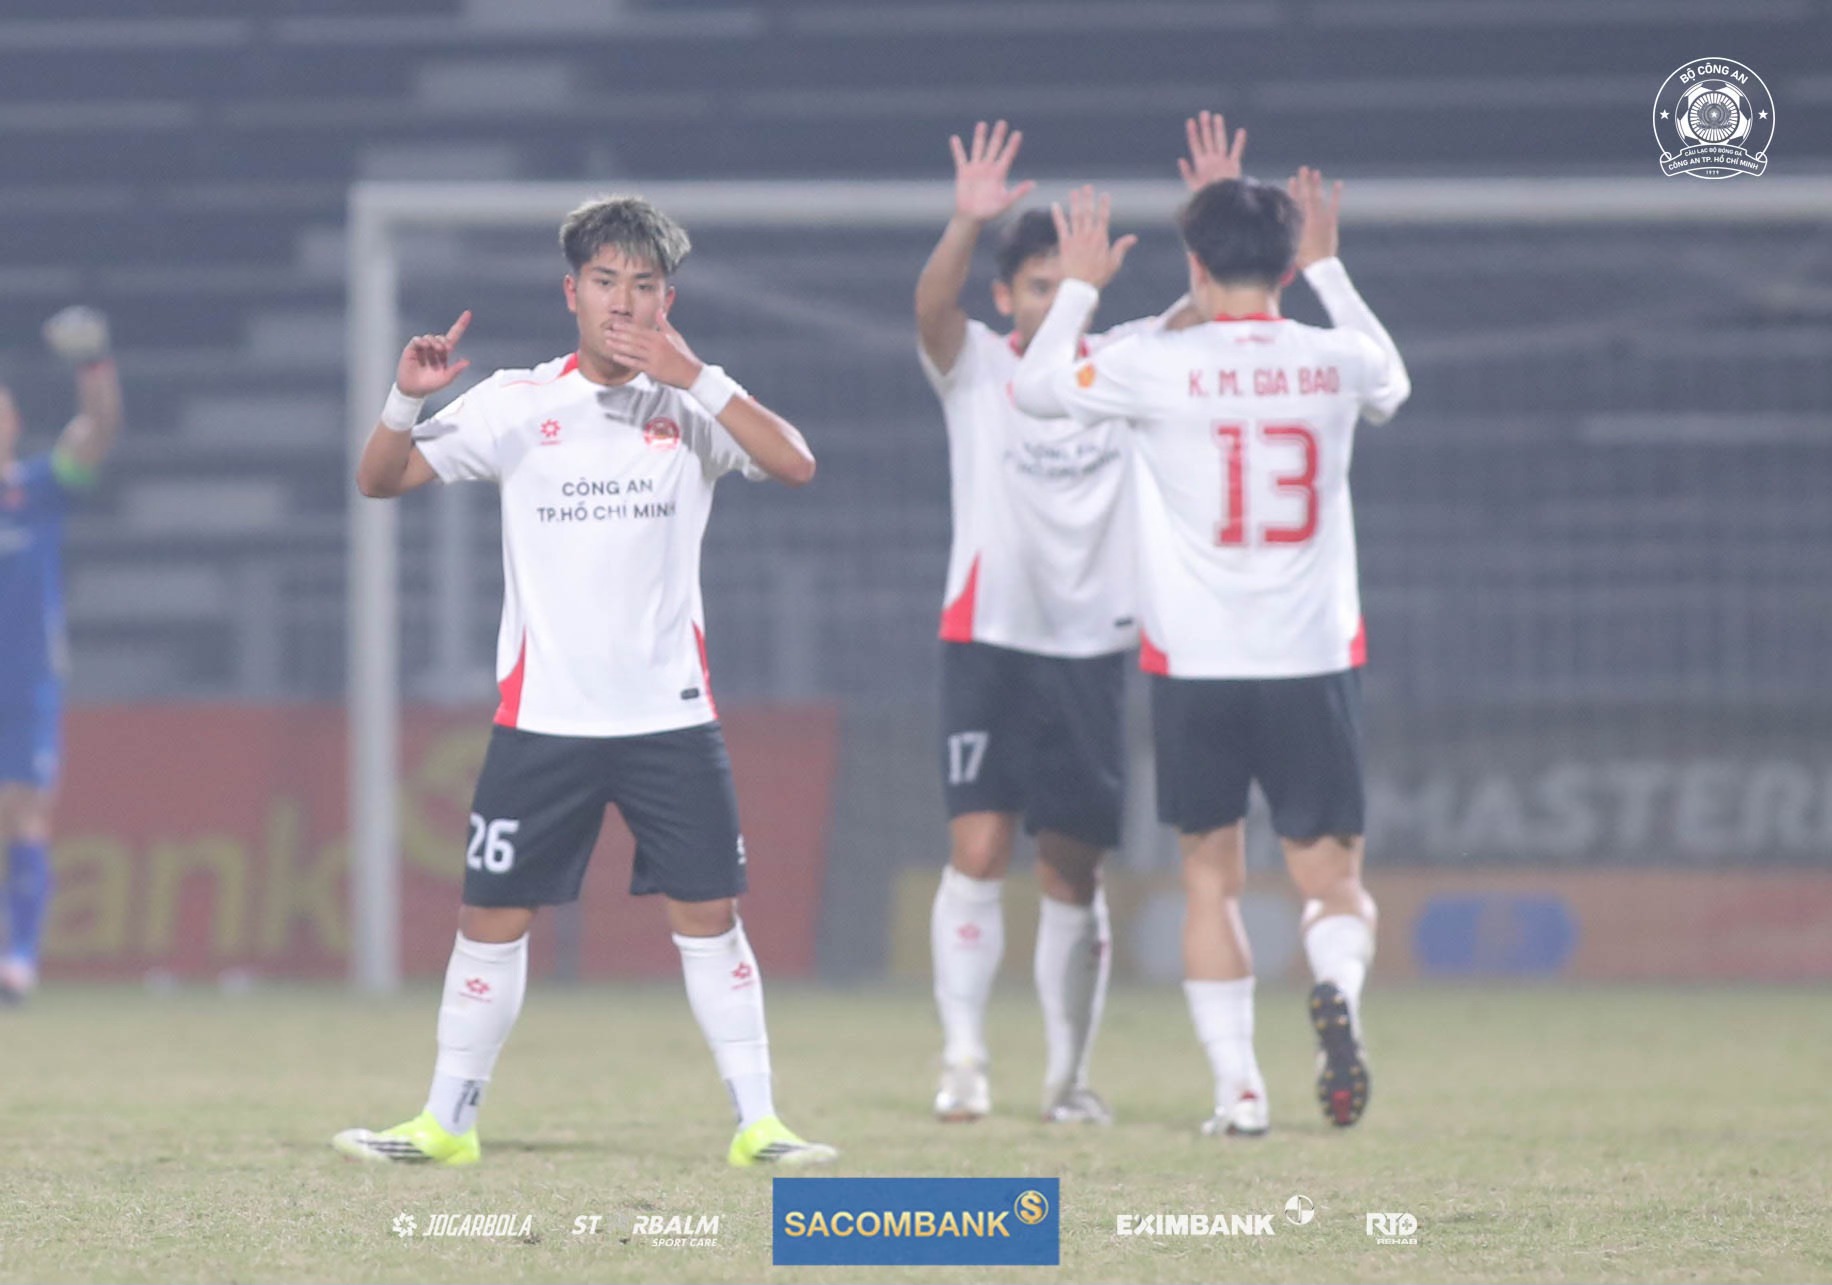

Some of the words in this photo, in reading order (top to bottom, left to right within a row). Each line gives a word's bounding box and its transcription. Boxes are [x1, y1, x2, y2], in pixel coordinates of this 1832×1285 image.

[1252, 367, 1290, 397] GIA
[561, 477, 620, 497] CÔNG
[626, 479, 653, 495] AN
[1213, 421, 1321, 547] 13
[948, 730, 990, 786] 17
[1364, 757, 1832, 855] MASTER
[466, 811, 520, 874] 26
